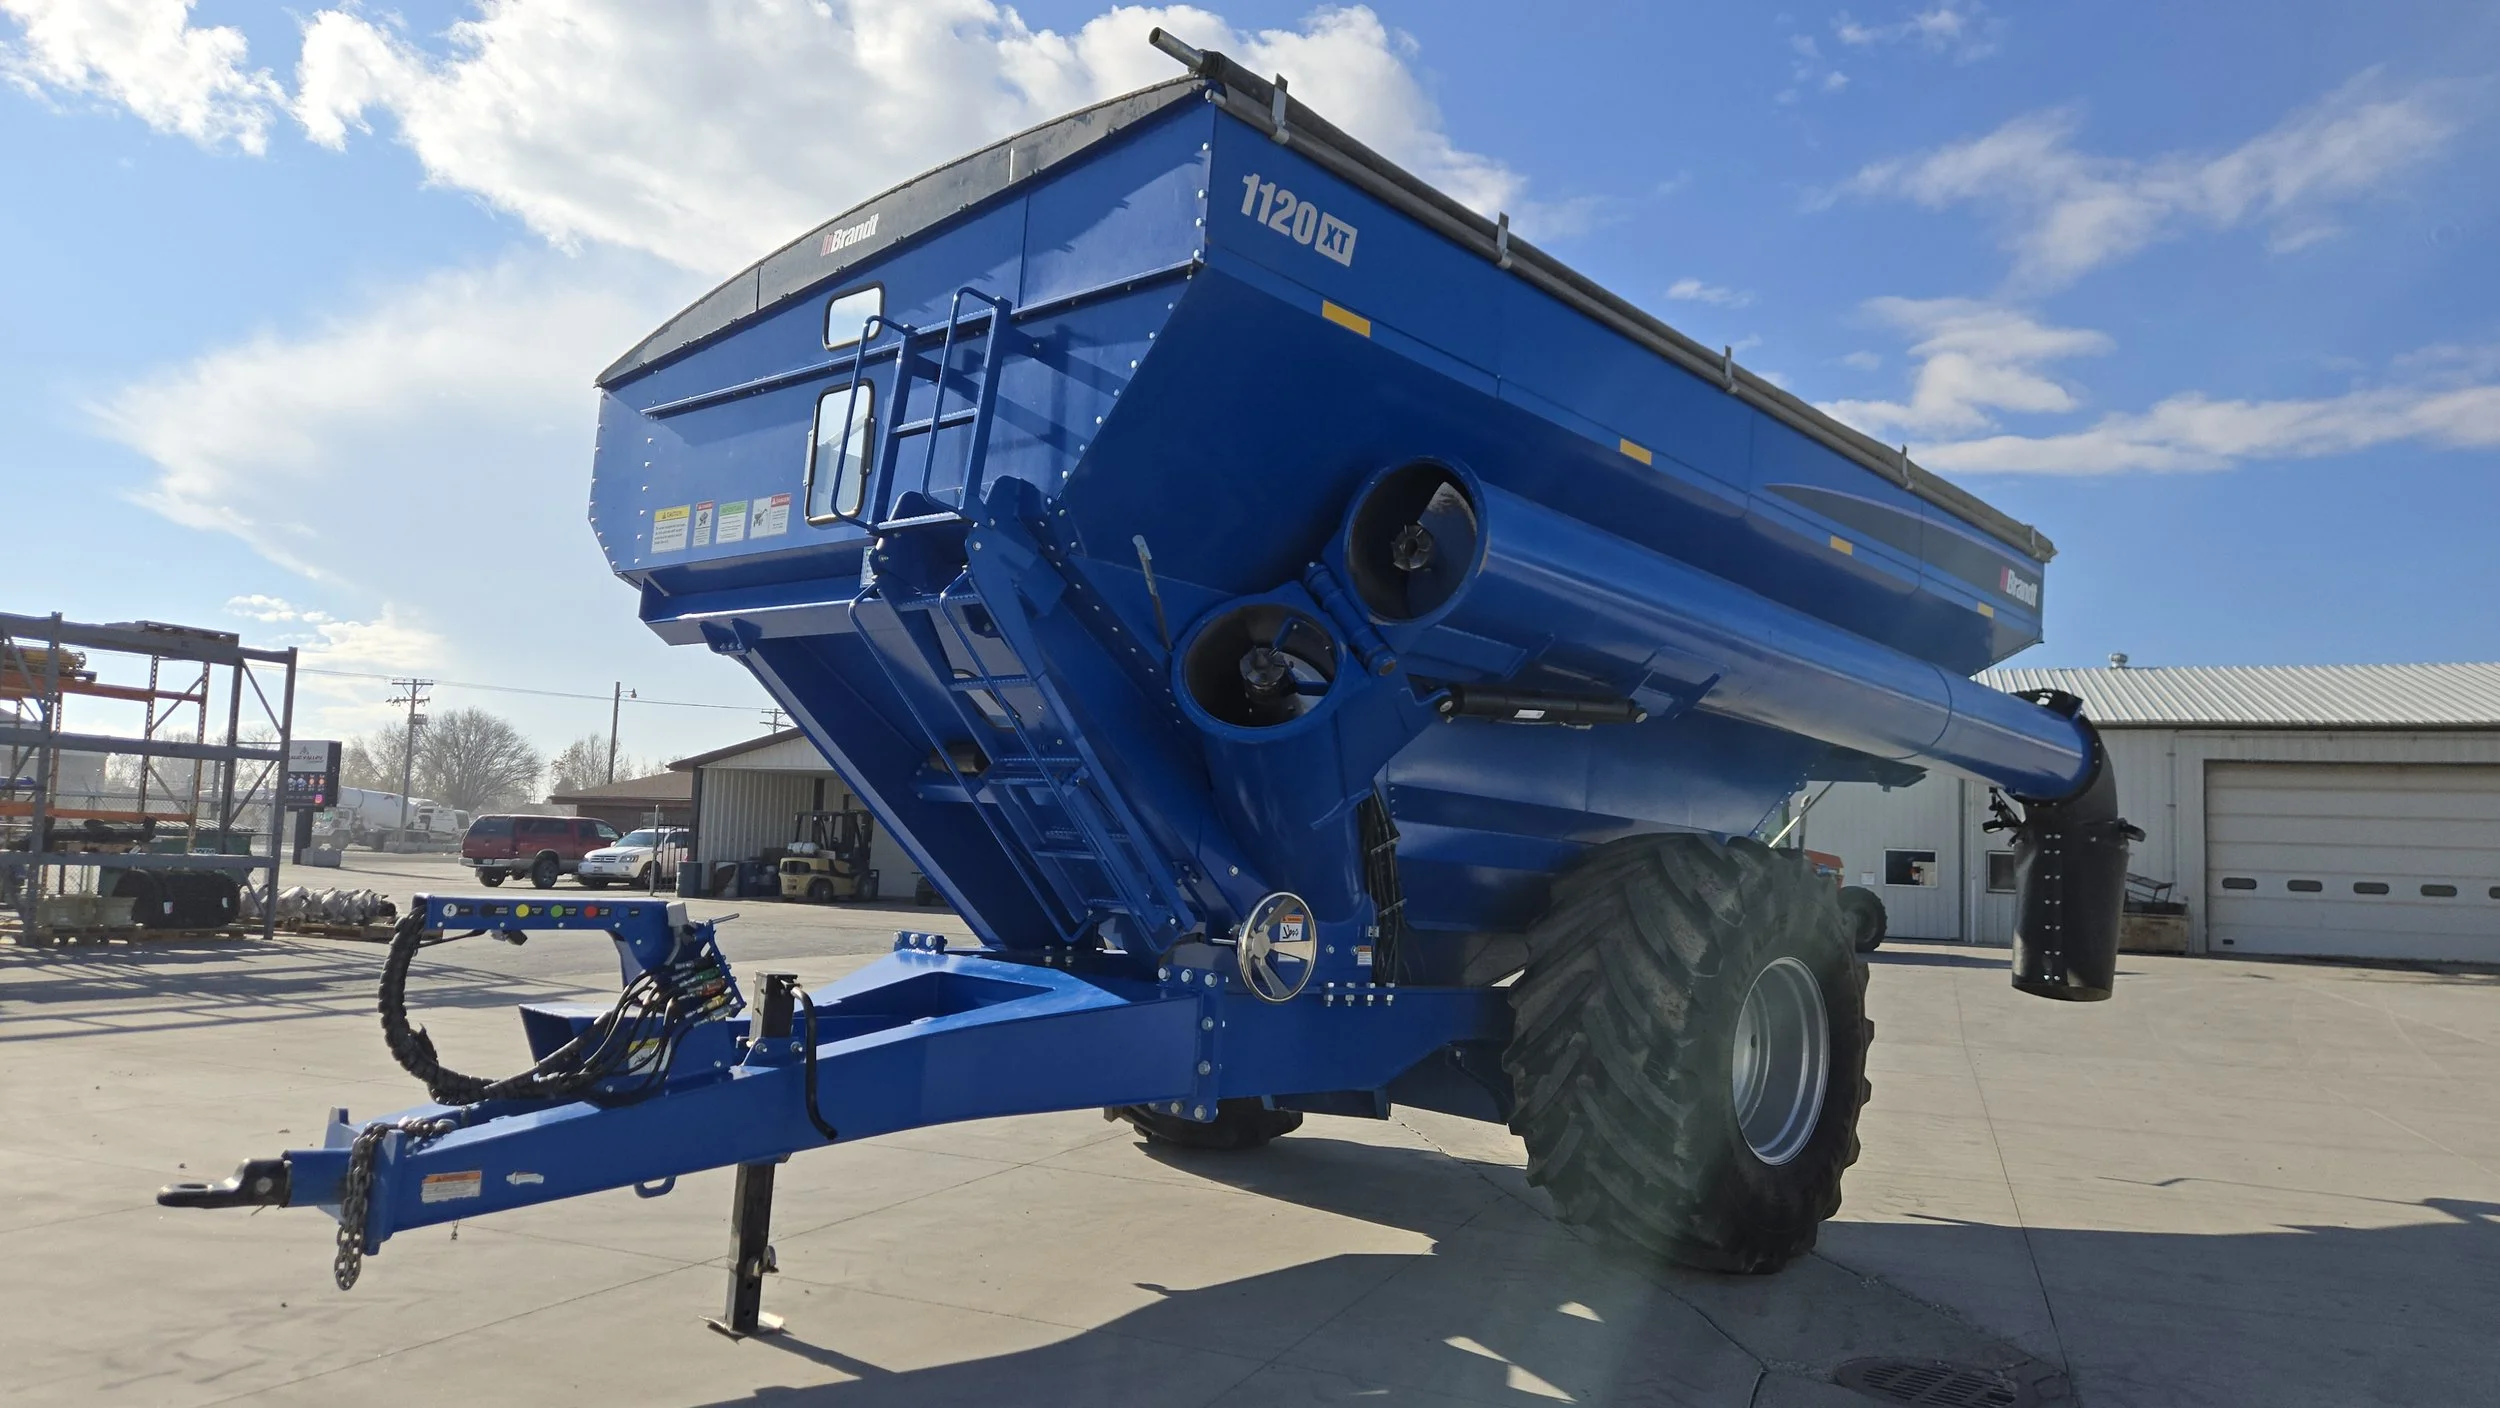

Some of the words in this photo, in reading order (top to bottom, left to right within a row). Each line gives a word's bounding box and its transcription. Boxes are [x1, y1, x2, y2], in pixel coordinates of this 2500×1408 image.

[829, 213, 879, 253] Brandt
[1241, 173, 1318, 245] 1120
[1321, 221, 1351, 255] XT
[2005, 568, 2038, 608] Brandt
